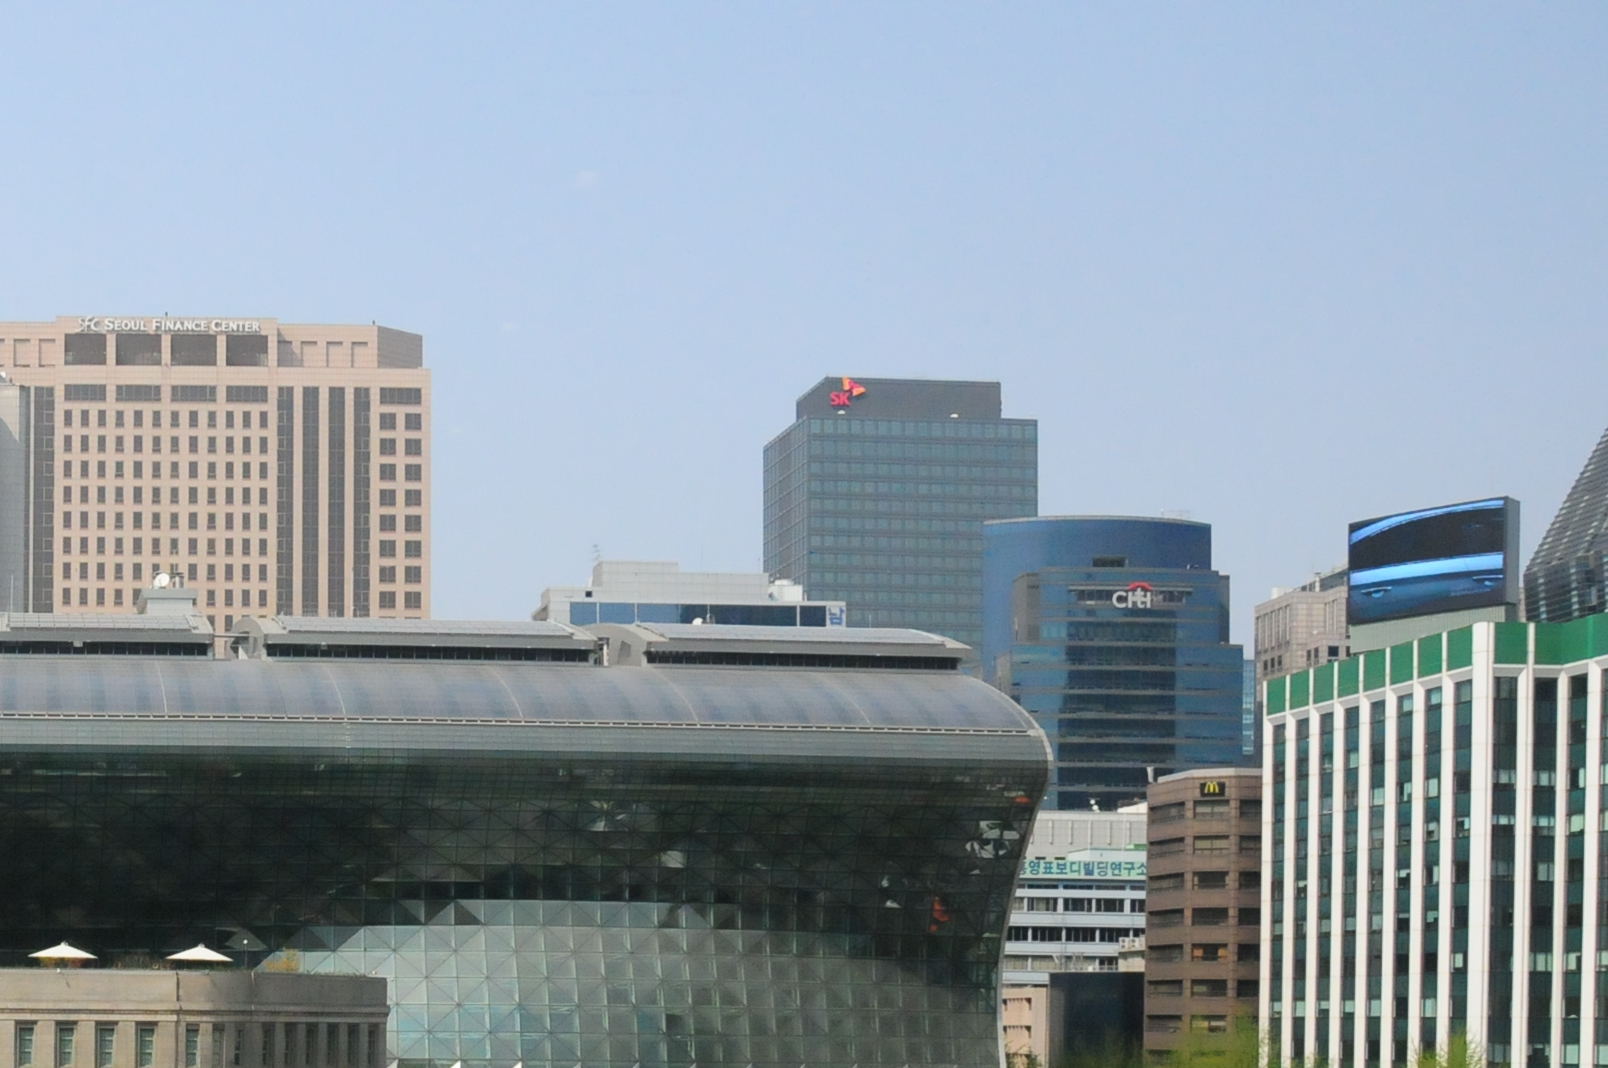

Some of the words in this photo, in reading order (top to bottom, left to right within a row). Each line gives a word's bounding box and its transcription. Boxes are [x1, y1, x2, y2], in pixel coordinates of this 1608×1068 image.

[104, 318, 147, 331] SEOUL
[152, 319, 208, 332] FINANCE
[211, 319, 260, 332] CENTER
[830, 391, 851, 406] SK
